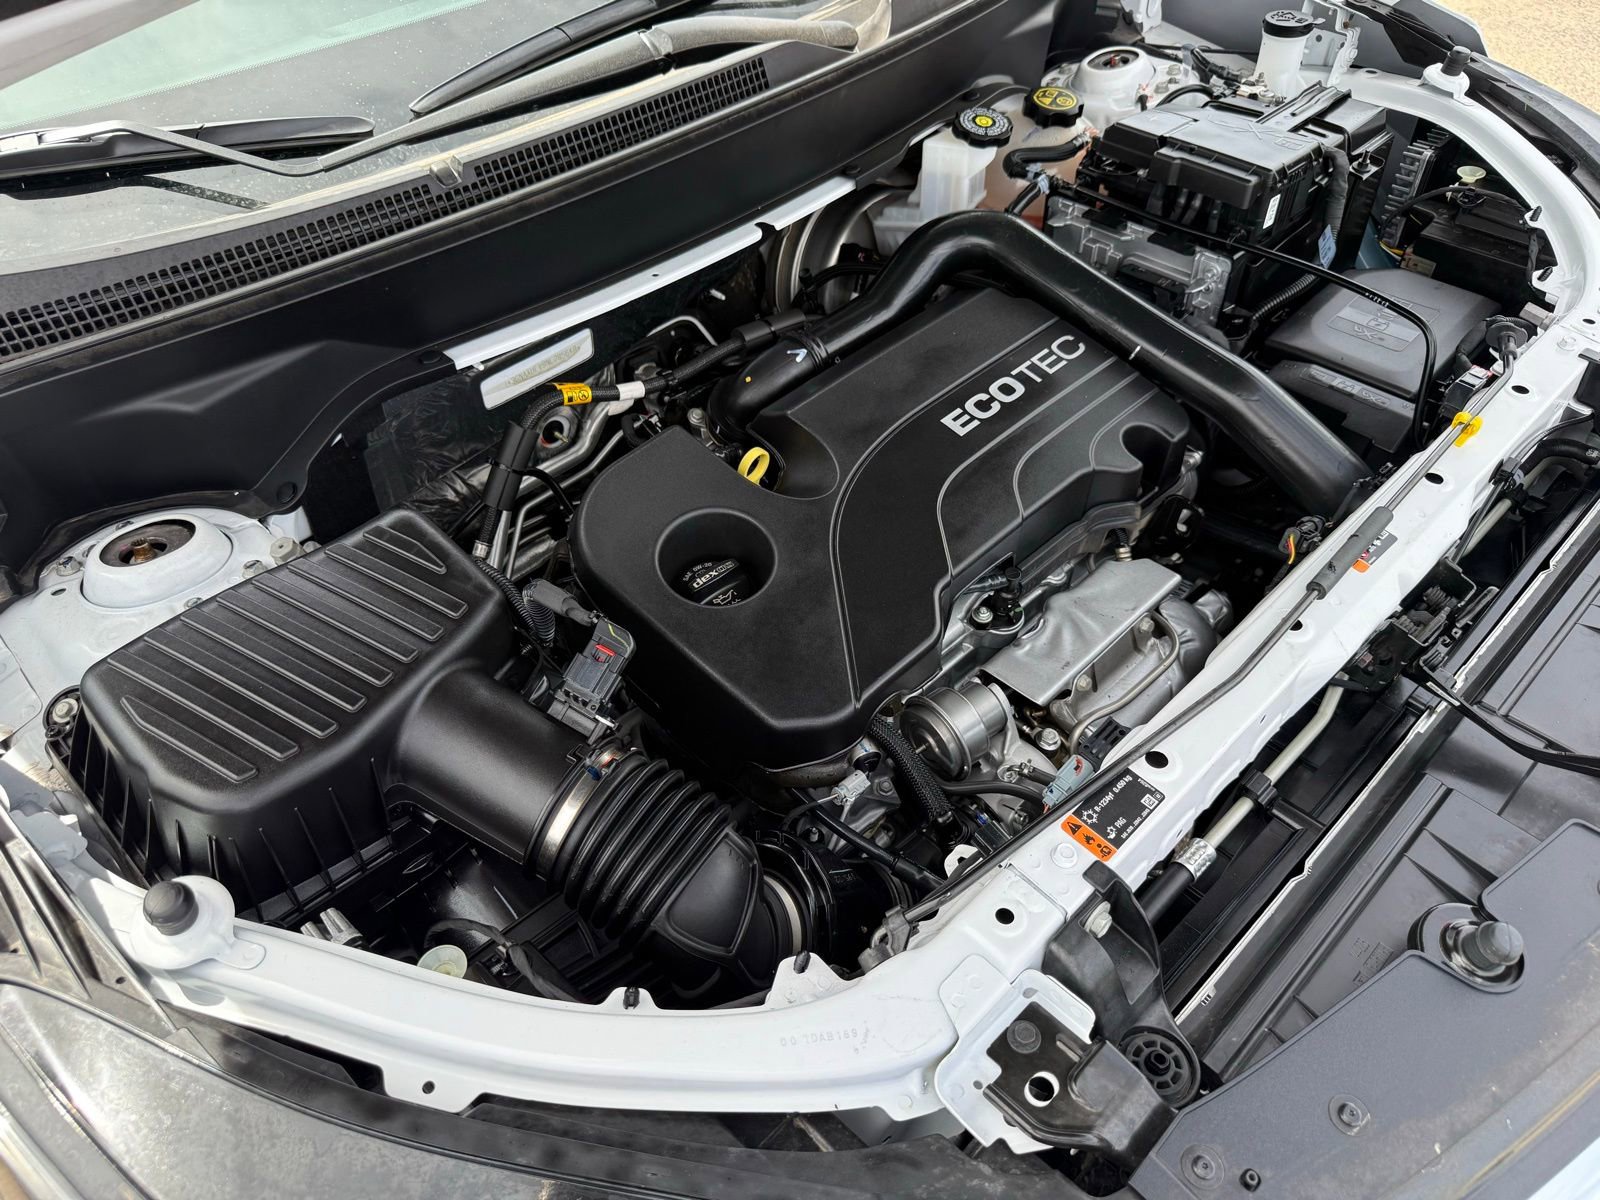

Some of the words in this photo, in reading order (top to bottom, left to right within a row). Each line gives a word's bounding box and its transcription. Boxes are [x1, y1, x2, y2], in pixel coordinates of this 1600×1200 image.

[940, 335, 1086, 437] ECOTEC
[1094, 792, 1115, 812] R-1234yf
[1115, 816, 1127, 828] PAG
